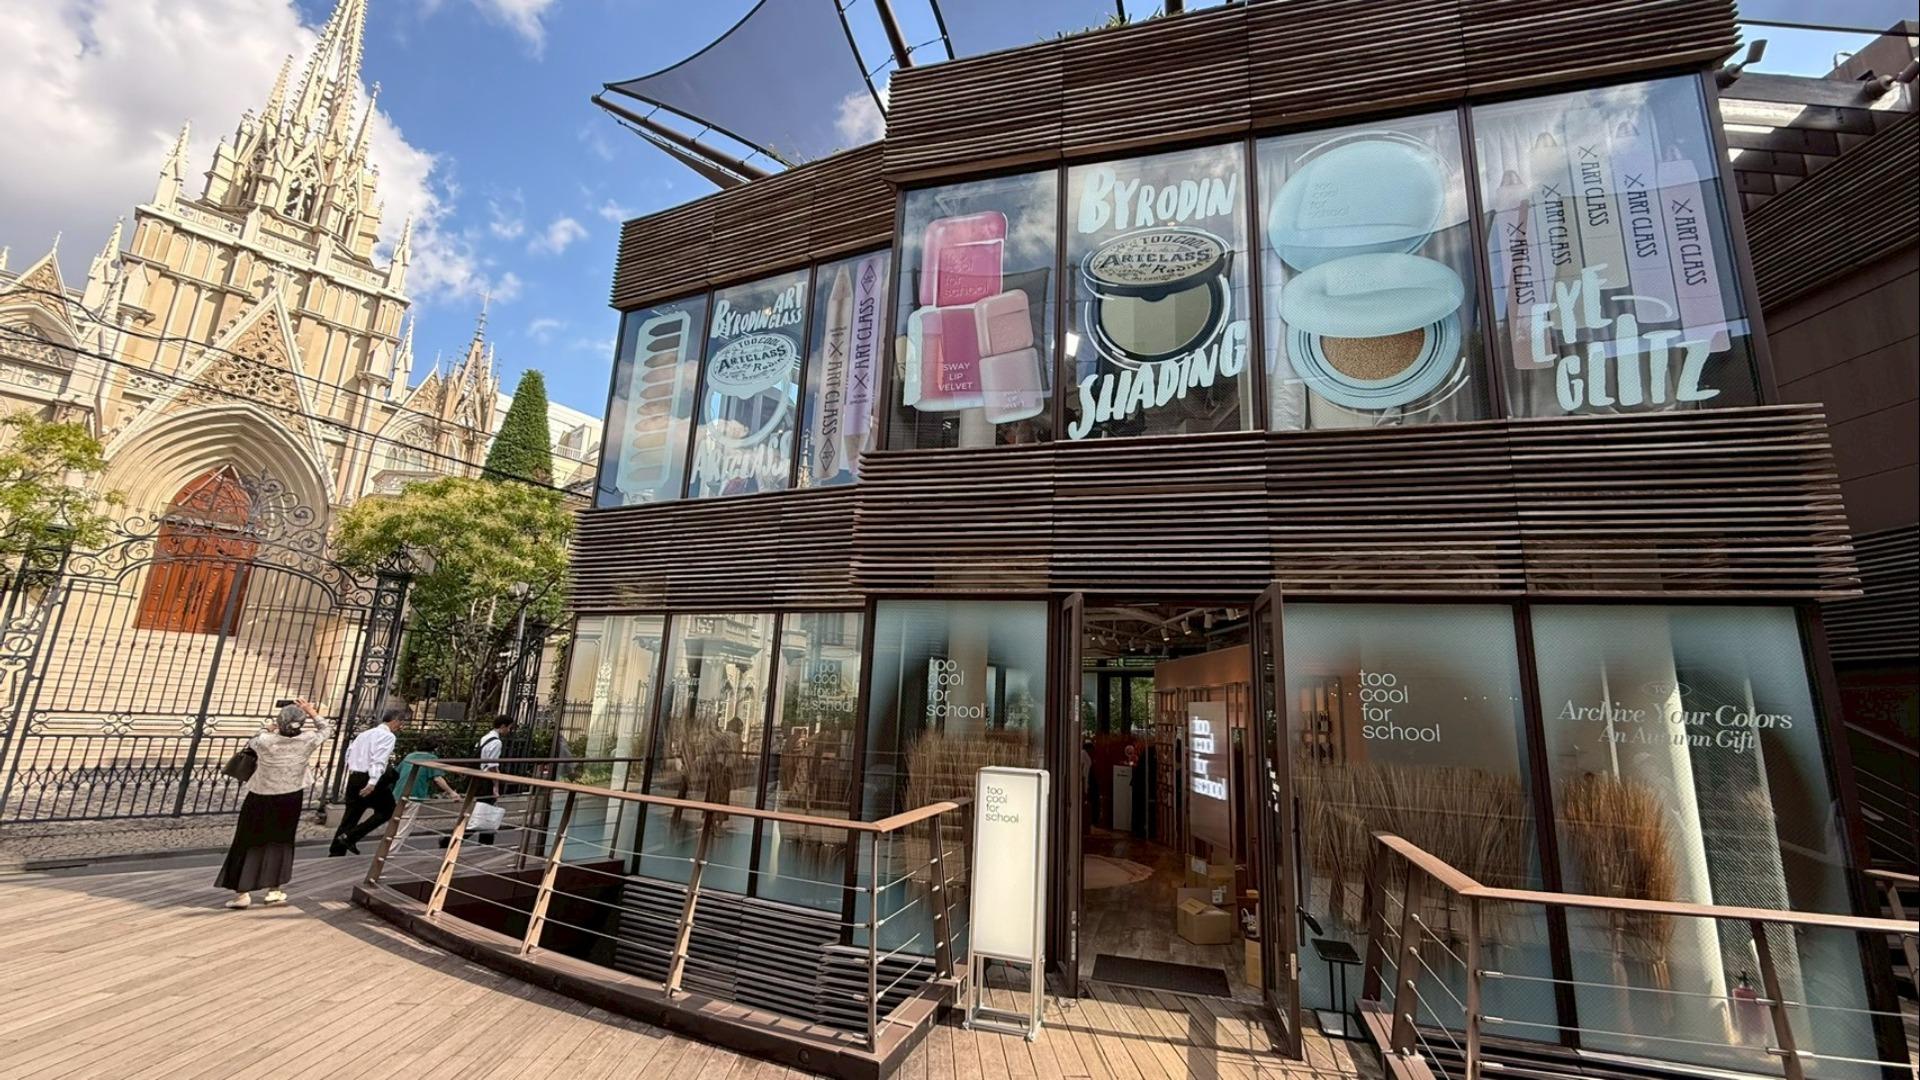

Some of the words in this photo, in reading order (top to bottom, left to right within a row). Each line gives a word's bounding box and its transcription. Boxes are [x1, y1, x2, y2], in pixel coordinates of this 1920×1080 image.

[773, 281, 807, 313] ART
[1531, 262, 1614, 363] EYE
[943, 362, 970, 372] SWAY
[1556, 313, 1721, 411] GLITZ
[949, 373, 964, 382] LIP
[1068, 320, 1248, 440] SHADING
[938, 383, 973, 393] VELVET
[928, 656, 957, 671] too
[928, 670, 965, 686] cool
[1358, 669, 1397, 686] too
[928, 685, 951, 701] for
[1360, 685, 1408, 703] cool
[926, 701, 985, 718] school
[1361, 702, 1393, 721] for
[1557, 700, 1646, 723] Archive
[1652, 702, 1711, 726] Your
[1715, 704, 1793, 729] Colors
[1362, 721, 1441, 742] school
[1598, 726, 1627, 744] An
[1715, 729, 1755, 753] Gift
[986, 785, 1003, 795] too
[986, 795, 1007, 803] cool
[986, 803, 999, 812] for
[985, 812, 1019, 823] school
